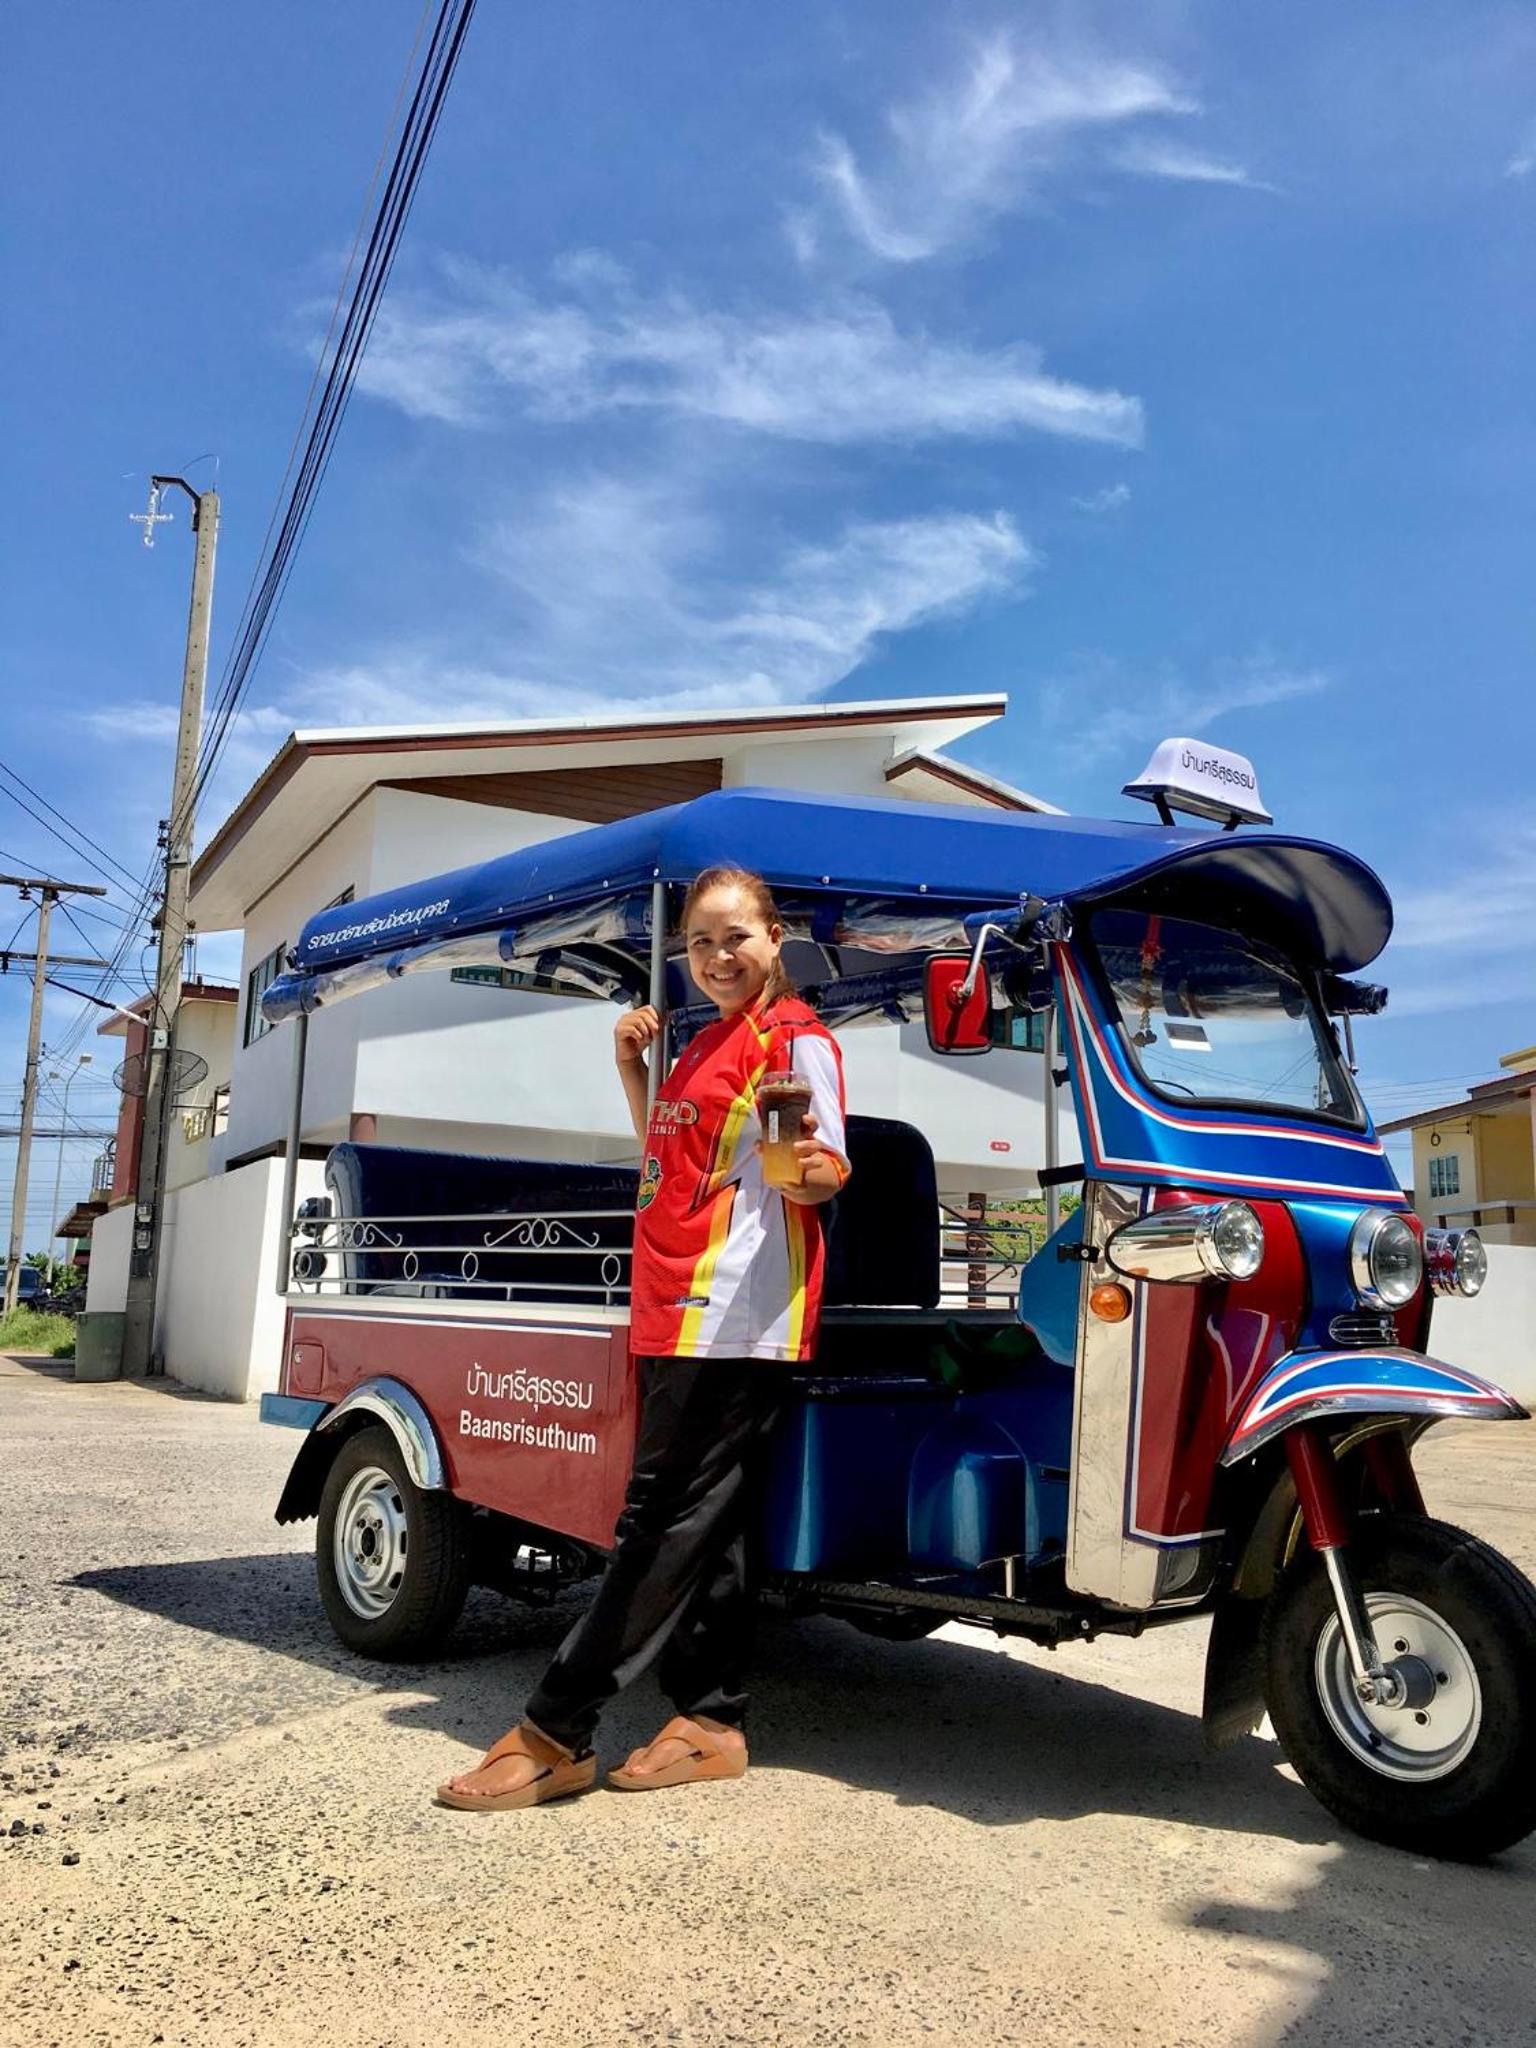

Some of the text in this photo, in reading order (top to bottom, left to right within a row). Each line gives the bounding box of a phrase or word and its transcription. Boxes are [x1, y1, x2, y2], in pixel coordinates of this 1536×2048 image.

[1181, 749, 1255, 790] บ้านศรีสุธรรม
[466, 1362, 593, 1412] บ้านศรีสุธรรม
[459, 1409, 596, 1455] Baansrisuthum
